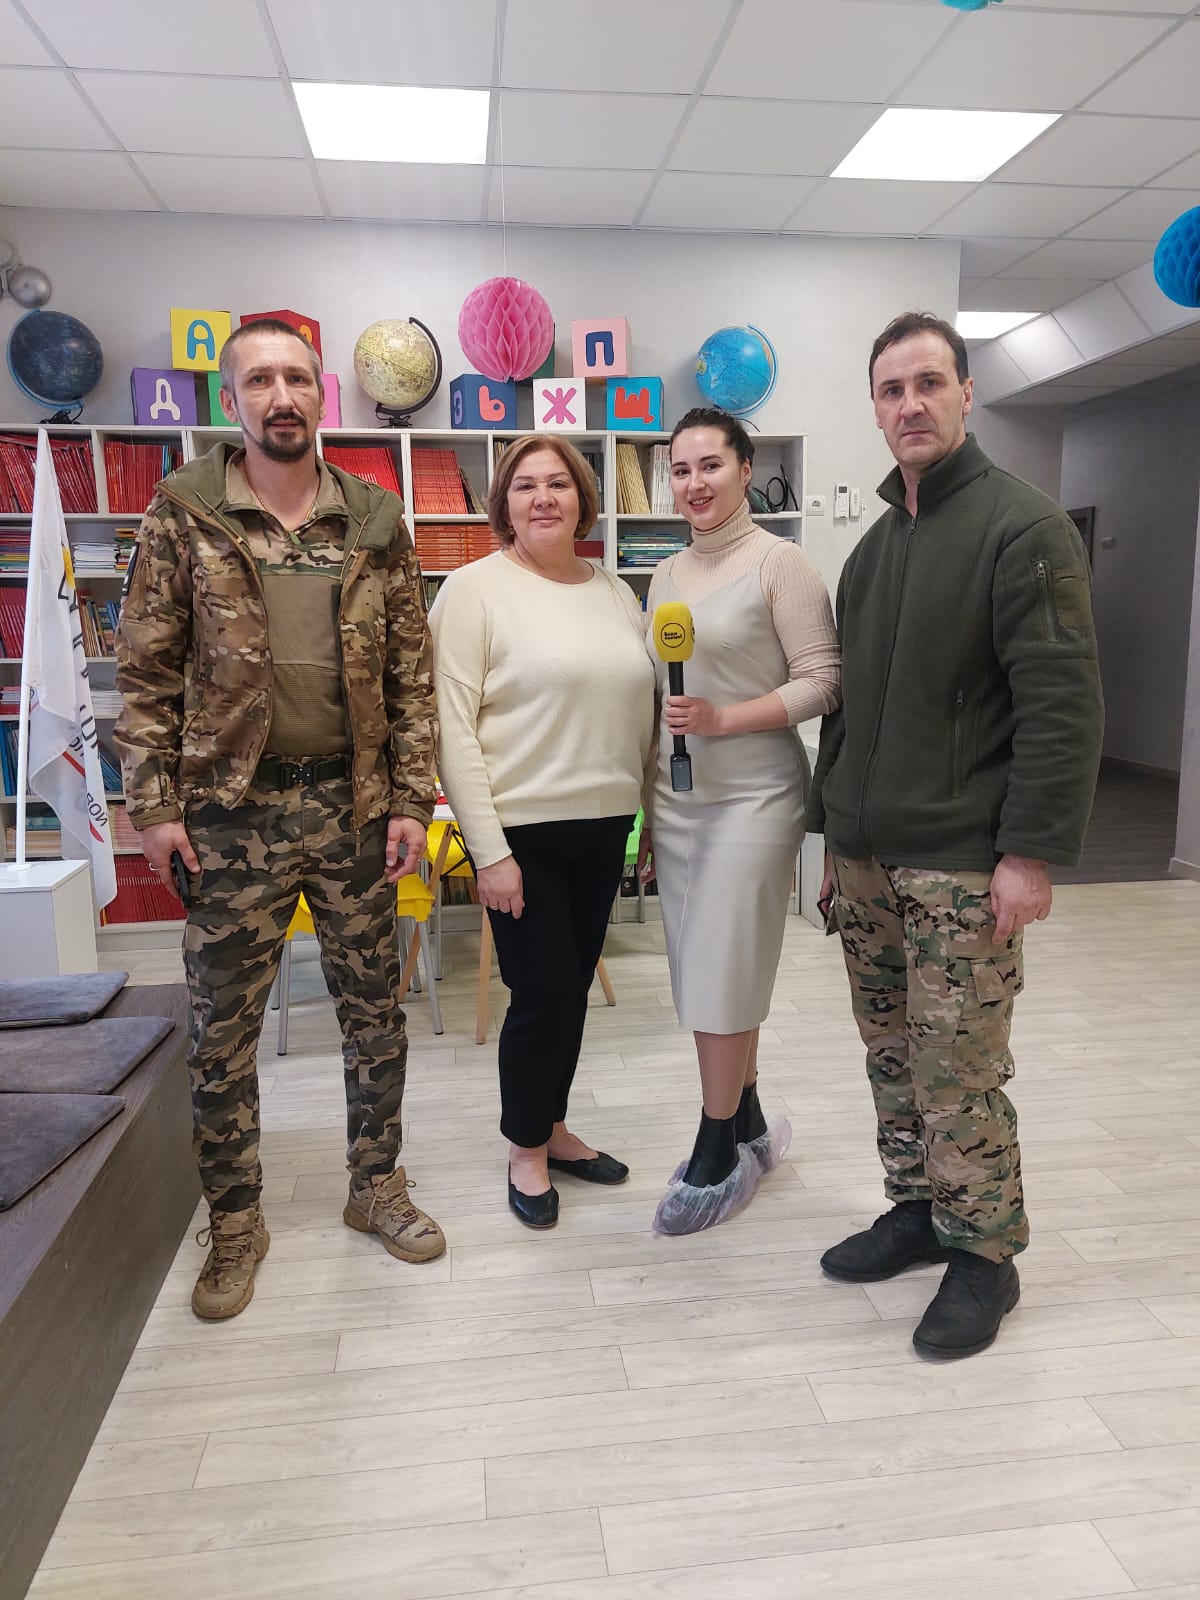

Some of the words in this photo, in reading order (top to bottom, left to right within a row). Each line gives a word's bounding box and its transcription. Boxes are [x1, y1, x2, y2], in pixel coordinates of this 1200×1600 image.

[187, 320, 215, 360] А
[586, 331, 614, 366] П
[150, 378, 181, 420] Д
[543, 388, 577, 424] Ж
[614, 387, 654, 424] Щ
